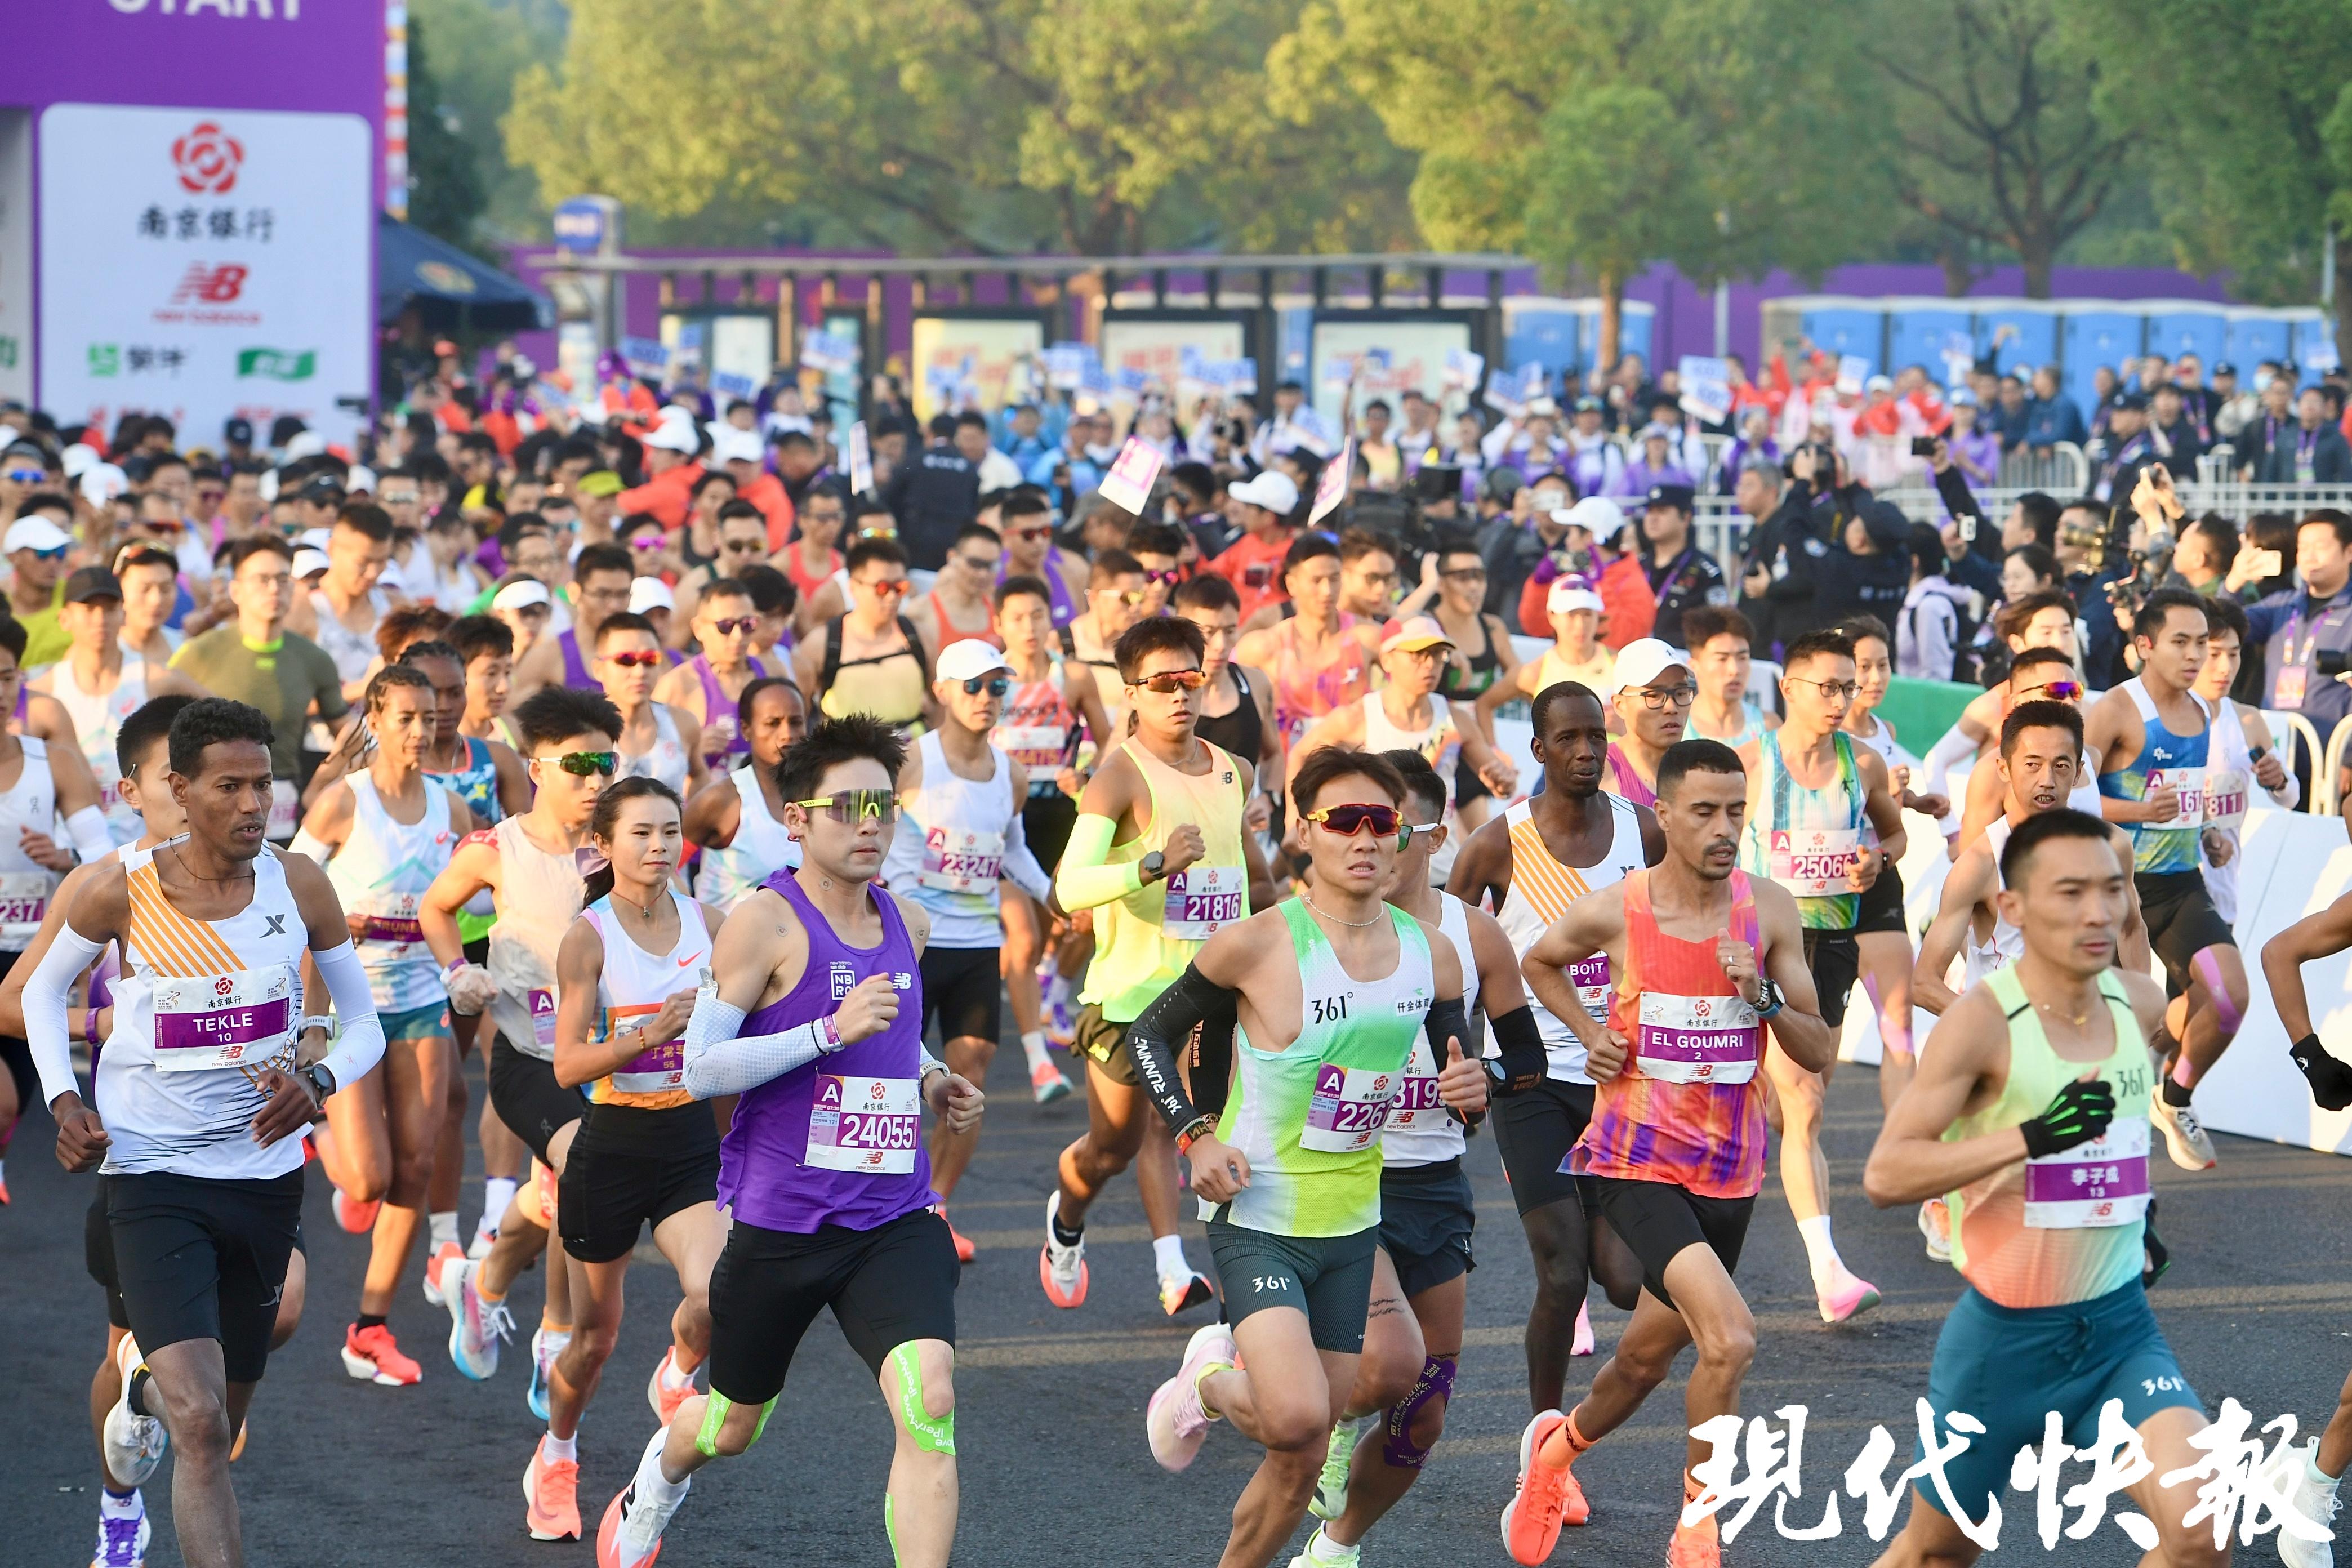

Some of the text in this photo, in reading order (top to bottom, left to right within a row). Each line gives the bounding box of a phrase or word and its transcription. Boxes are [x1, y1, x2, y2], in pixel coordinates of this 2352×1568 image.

[139, 205, 274, 242] 南京银行
[2150, 773, 2163, 787] A
[930, 831, 944, 846] A
[1776, 835, 1789, 850] A
[941, 854, 999, 877] 23247
[1172, 873, 1186, 889] A
[1187, 894, 1240, 921] 21816
[1570, 962, 1604, 976] BOIT
[835, 974, 852, 985] NB
[208, 995, 242, 1008] 南京银行
[537, 994, 552, 1012] A
[1397, 997, 1430, 1014] 仟金体育
[193, 1013, 253, 1032] TEKLE
[1686, 1019, 1718, 1027] 南京银行
[217, 1032, 232, 1043] 10
[1652, 1031, 1672, 1046] EL
[1677, 1035, 1743, 1049] GOUMRI
[1694, 1052, 1702, 1060] 2
[663, 1061, 675, 1069] 55
[1323, 1072, 1340, 1092] A
[821, 1084, 839, 1103] A
[1362, 1091, 1389, 1101] 南京银行
[862, 1102, 890, 1112] 南京银行
[840, 1115, 914, 1148] 24055
[1423, 1363, 1437, 1376] kind
[1429, 1366, 1441, 1378] max
